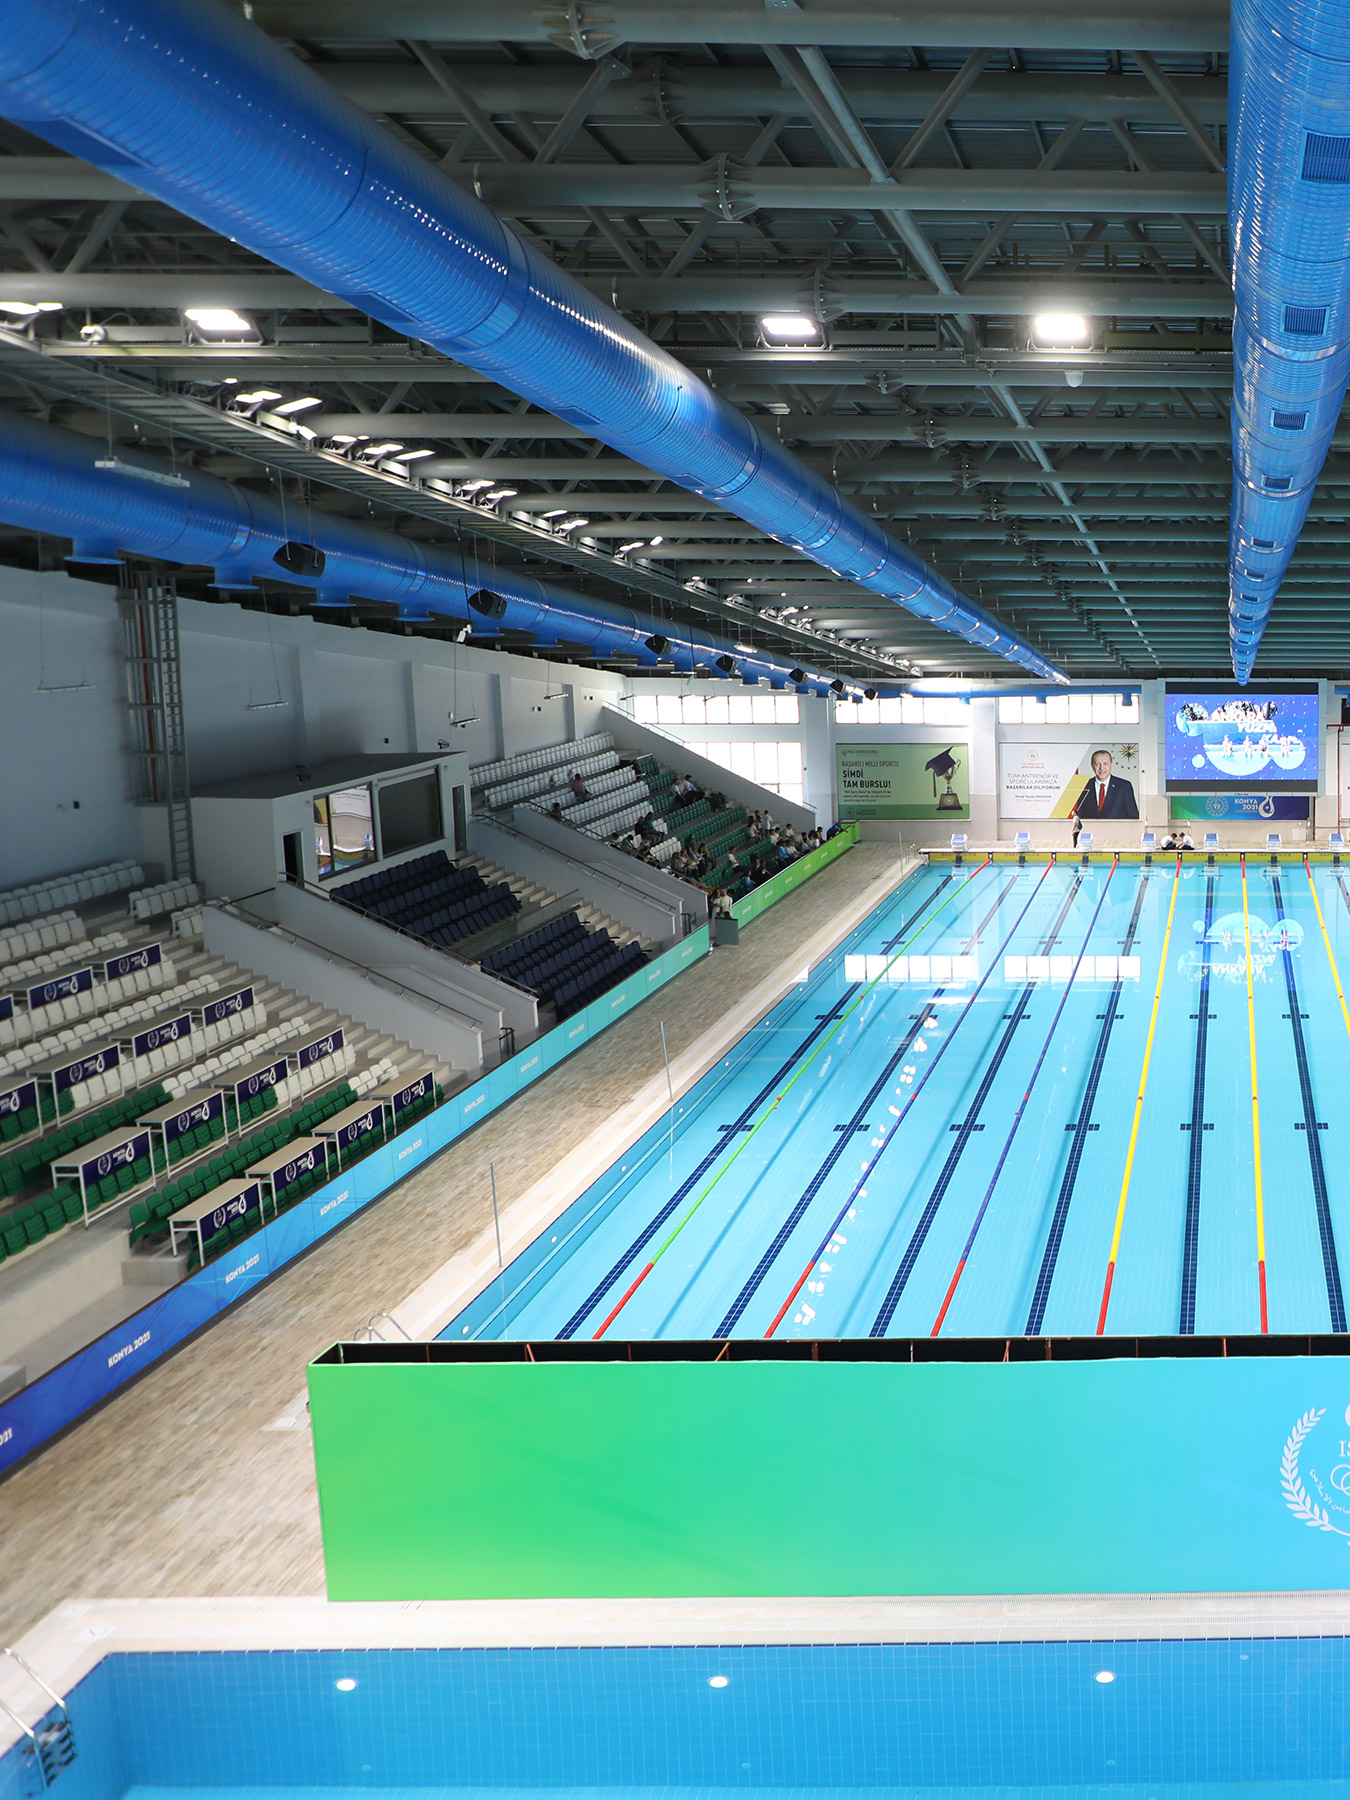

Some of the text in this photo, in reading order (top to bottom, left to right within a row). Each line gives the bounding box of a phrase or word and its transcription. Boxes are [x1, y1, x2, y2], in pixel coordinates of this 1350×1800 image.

[1211, 710, 1266, 721] ANKARA
[842, 769, 864, 778] ŞİMDİ
[842, 780, 891, 788] TAM BURSLU!
[225, 1253, 260, 1285] KONYA 2021
[108, 1330, 151, 1369] KONYA 2021
